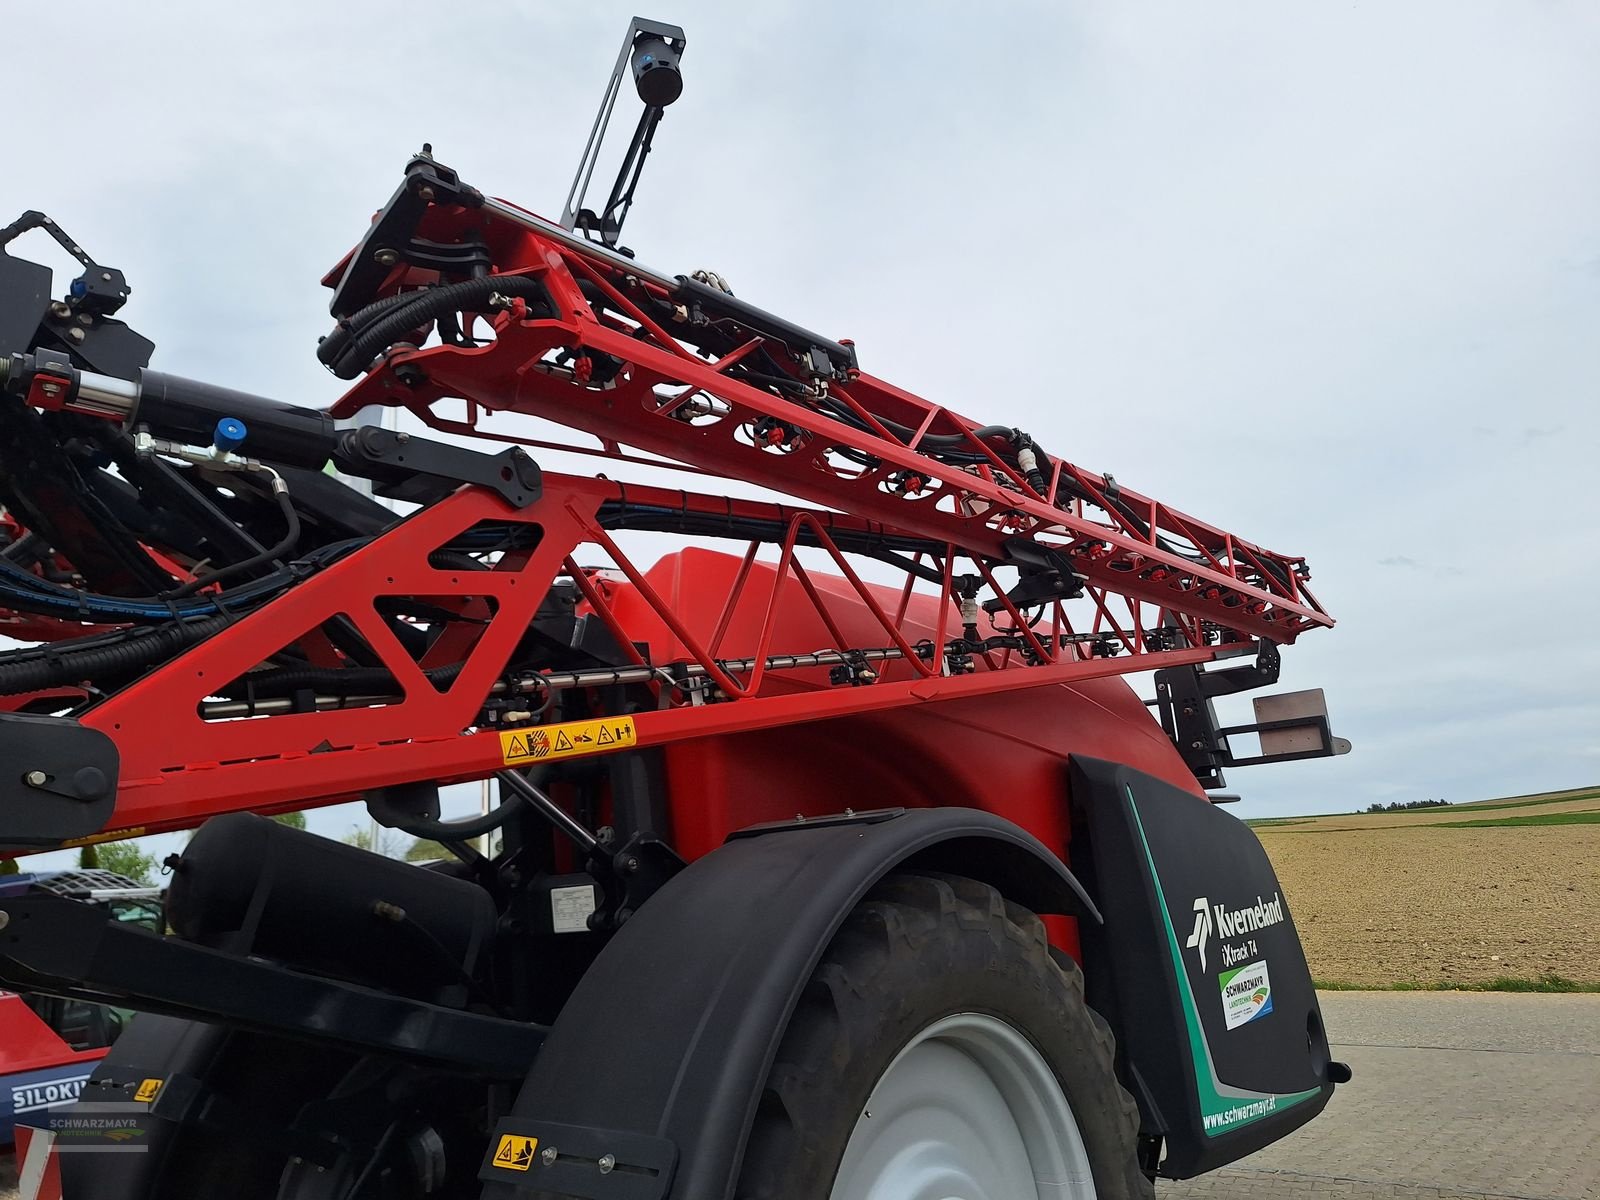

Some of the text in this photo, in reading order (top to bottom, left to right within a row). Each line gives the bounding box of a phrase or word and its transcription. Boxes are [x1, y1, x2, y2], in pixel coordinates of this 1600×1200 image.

[1213, 892, 1284, 939] Kverneland
[1221, 939, 1258, 967] iXtrack T4
[1226, 975, 1264, 998] SCHWARZMAYR
[1203, 1093, 1276, 1130] www.schwarzmayr.at
